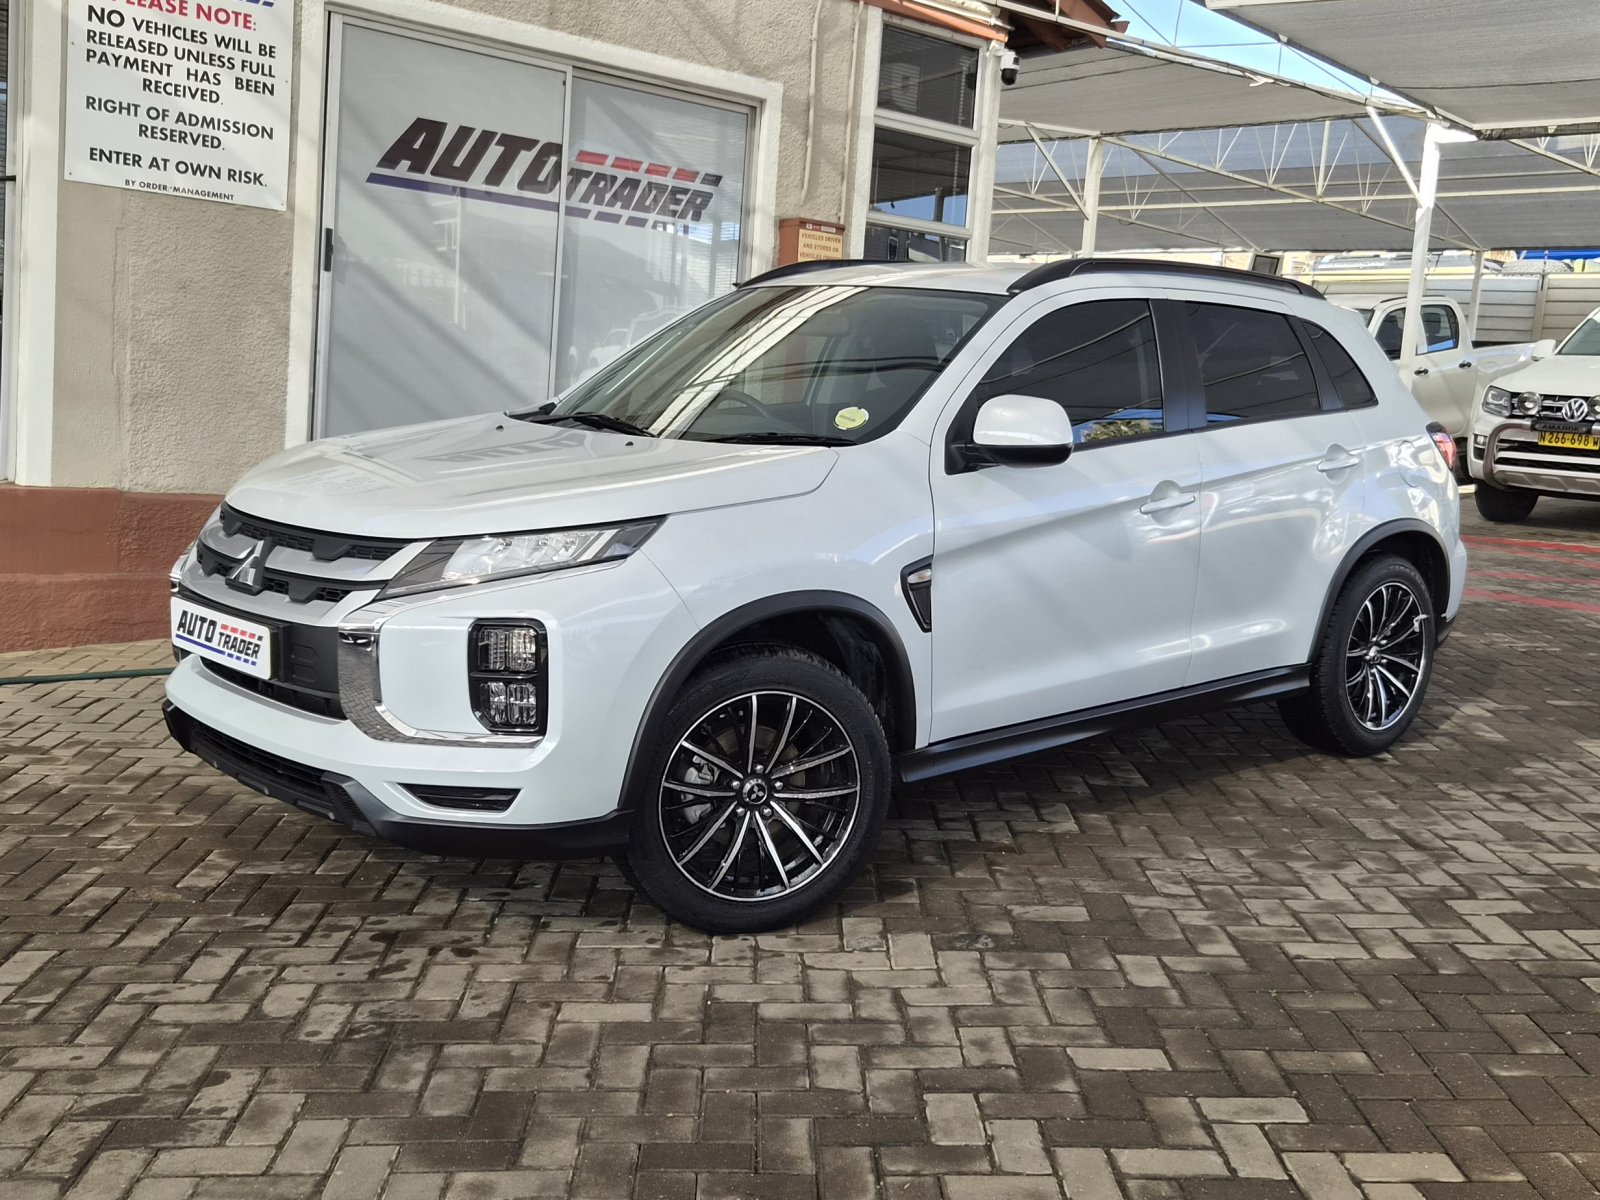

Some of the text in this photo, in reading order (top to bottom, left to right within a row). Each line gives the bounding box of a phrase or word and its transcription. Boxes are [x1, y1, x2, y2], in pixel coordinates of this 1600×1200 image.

[87, 5, 276, 59] NO VEHICLES WILL BE
[196, 3, 257, 31] NOTE:
[86, 29, 276, 78] RELEASED UNLESS FULL
[86, 48, 275, 96] PAYMENT HAS BEEN
[142, 78, 224, 105] RECEIVED.
[85, 95, 274, 140] RIGHT OF ADMISSION
[138, 124, 225, 151] RESERVED.
[89, 147, 268, 188] ENTER AT OWN RISK.
[124, 179, 136, 187] BY
[172, 186, 235, 201] MANAGEMENT
[375, 117, 714, 222] AUTO TRADER
[177, 609, 261, 660] AUTO TRADER
